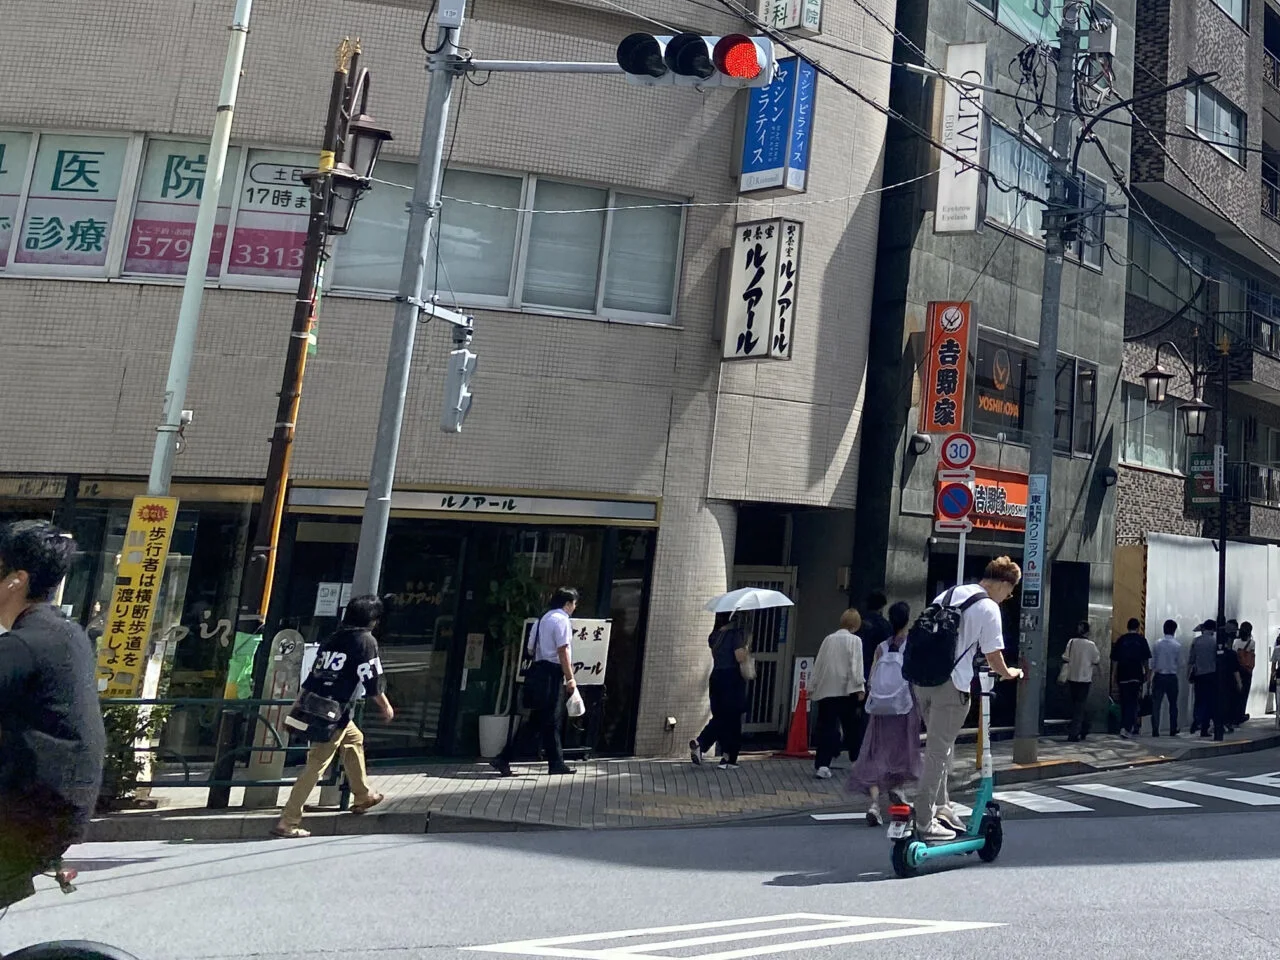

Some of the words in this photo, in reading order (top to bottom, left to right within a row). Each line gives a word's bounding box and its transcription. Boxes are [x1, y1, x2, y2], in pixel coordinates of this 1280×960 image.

[772, 69, 788, 122] マシン
[792, 69, 812, 163] マシンピラティス
[954, 70, 982, 178] OLIVIA
[246, 187, 311, 208] 17時ま
[735, 242, 769, 355] ルノアール
[772, 259, 796, 354] ルノアール
[933, 337, 961, 426] 吉野家
[948, 443, 969, 460] 30
[142, 506, 165, 521] 危ない
[441, 494, 518, 512] ルノアール
[974, 484, 1008, 515] 吉野家
[100, 588, 134, 682] 渡りましょう
[122, 527, 167, 667] 歩行者は横断歩道を
